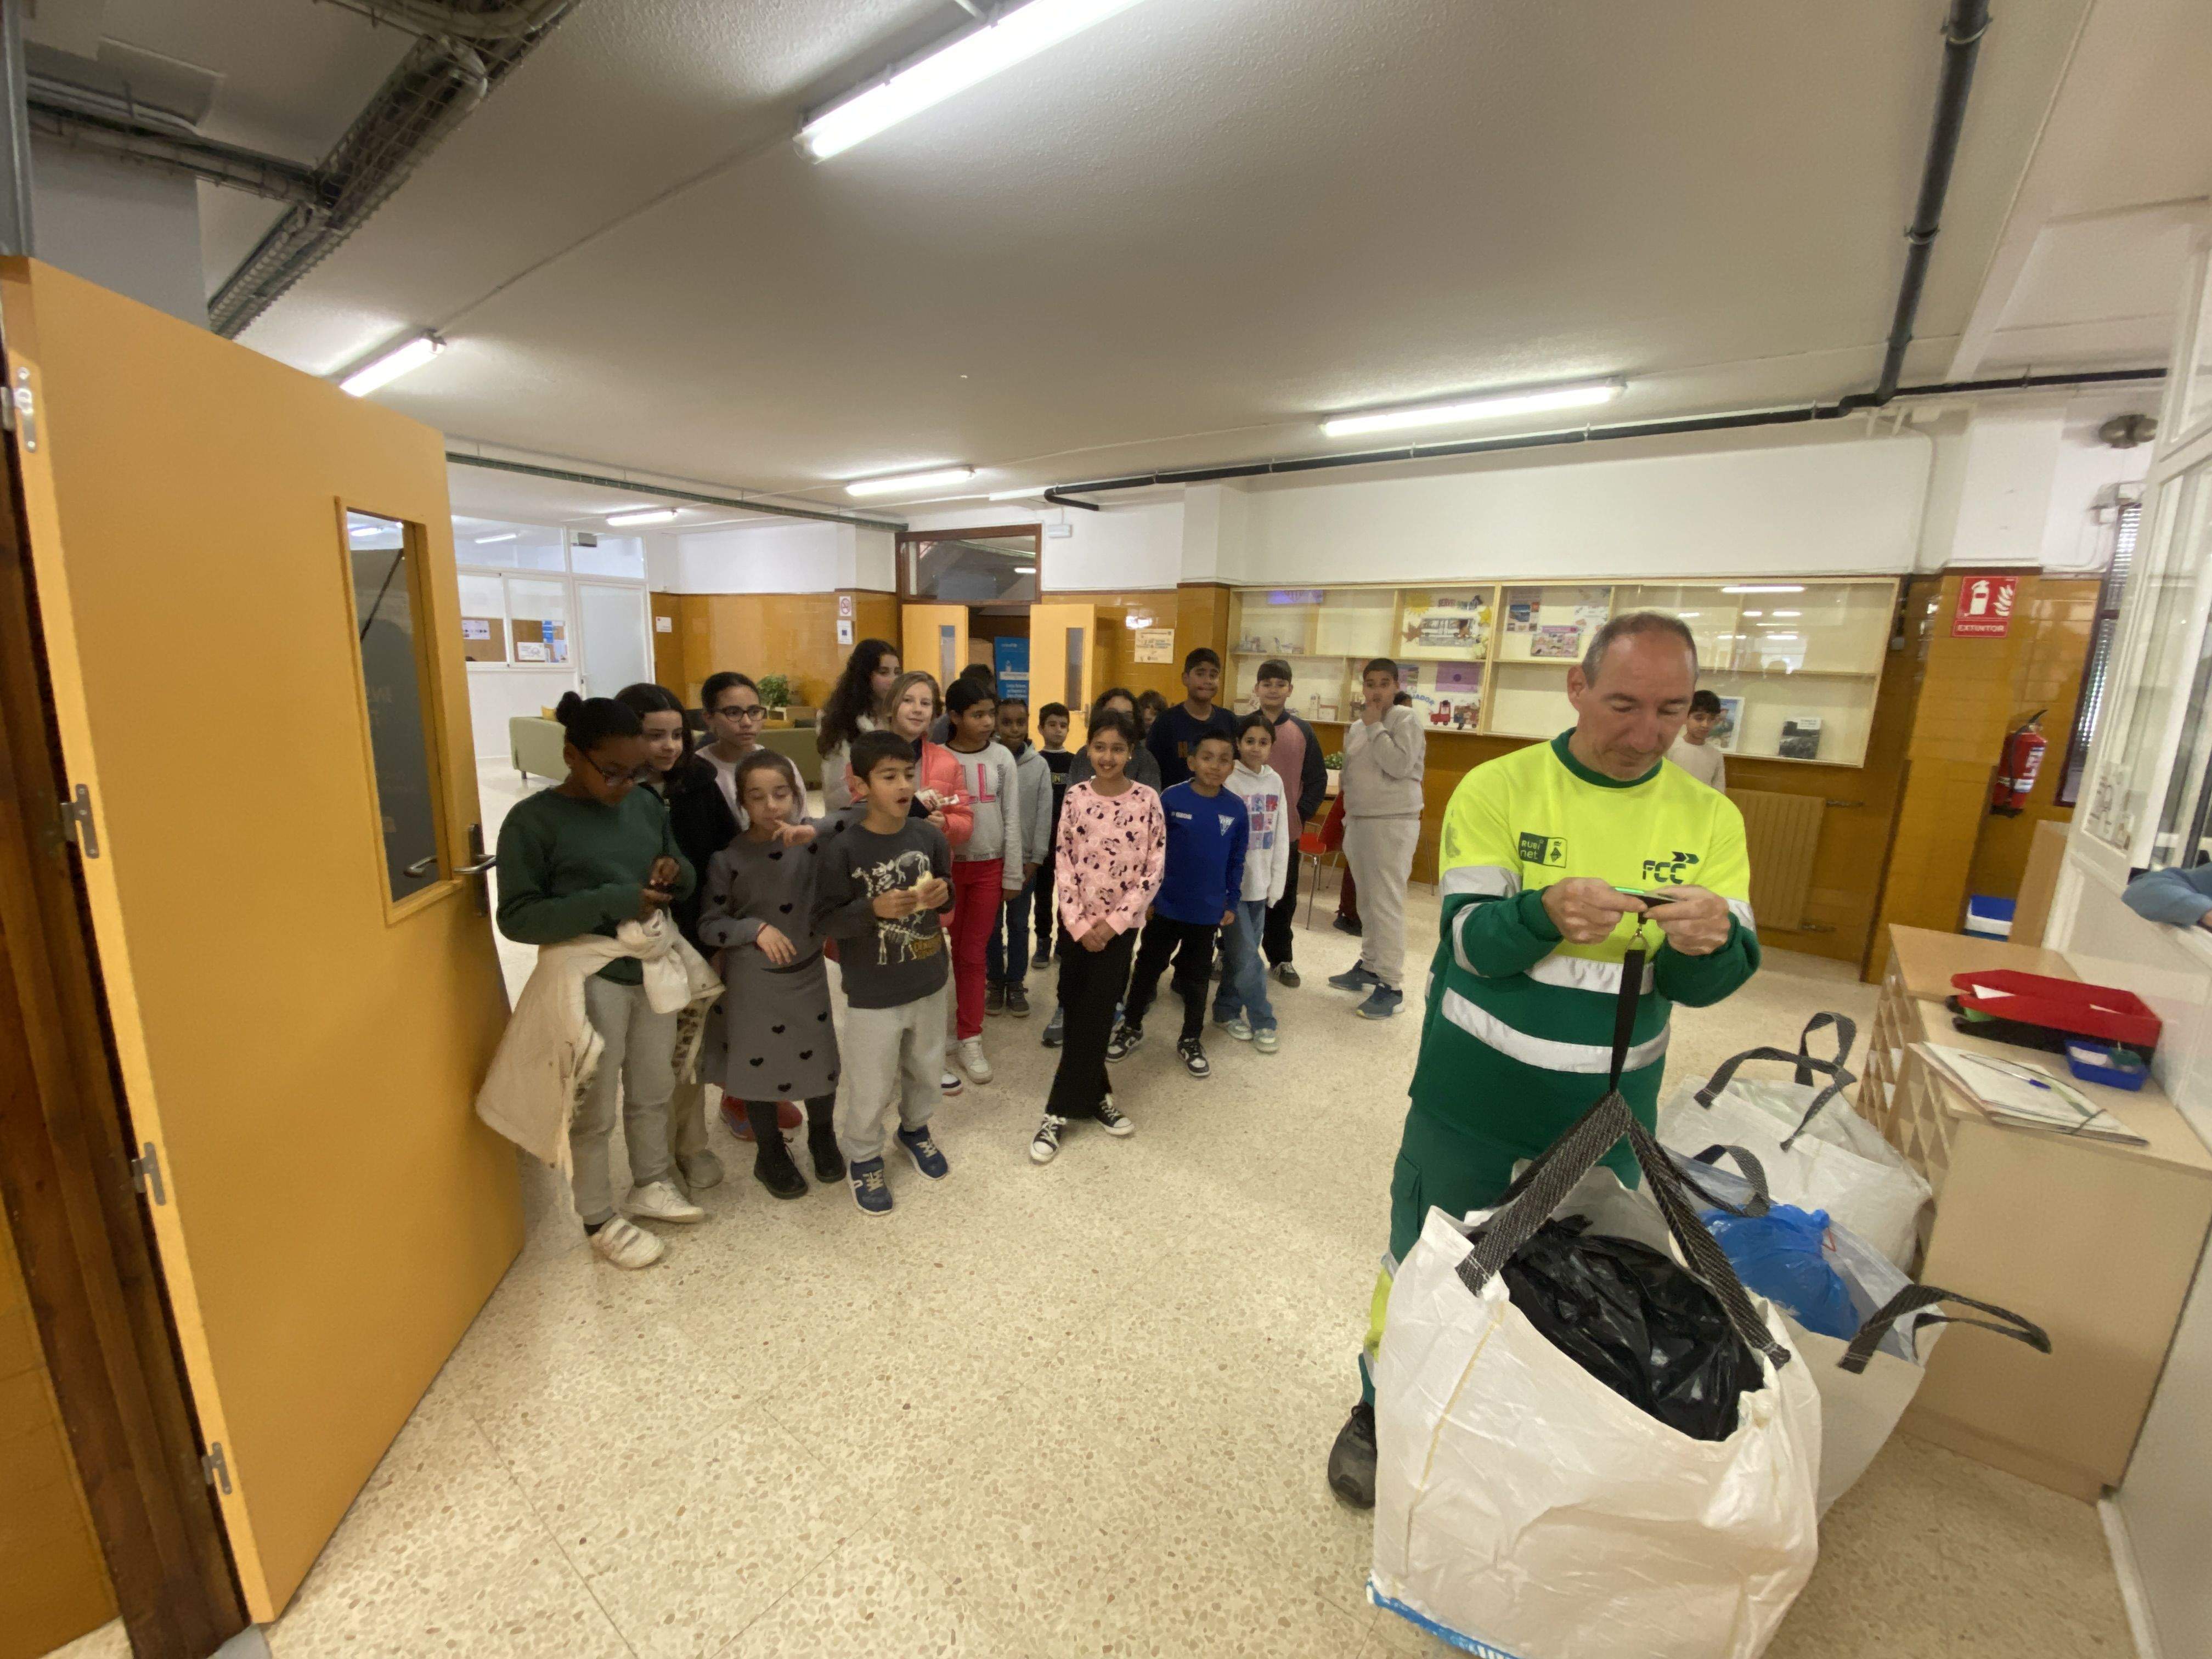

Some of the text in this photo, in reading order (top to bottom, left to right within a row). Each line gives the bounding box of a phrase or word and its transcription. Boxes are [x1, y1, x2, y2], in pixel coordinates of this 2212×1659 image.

[1957, 624, 2005, 633] EXTINTOR
[1520, 849, 1538, 860] net
[1643, 860, 1686, 884] FCC
